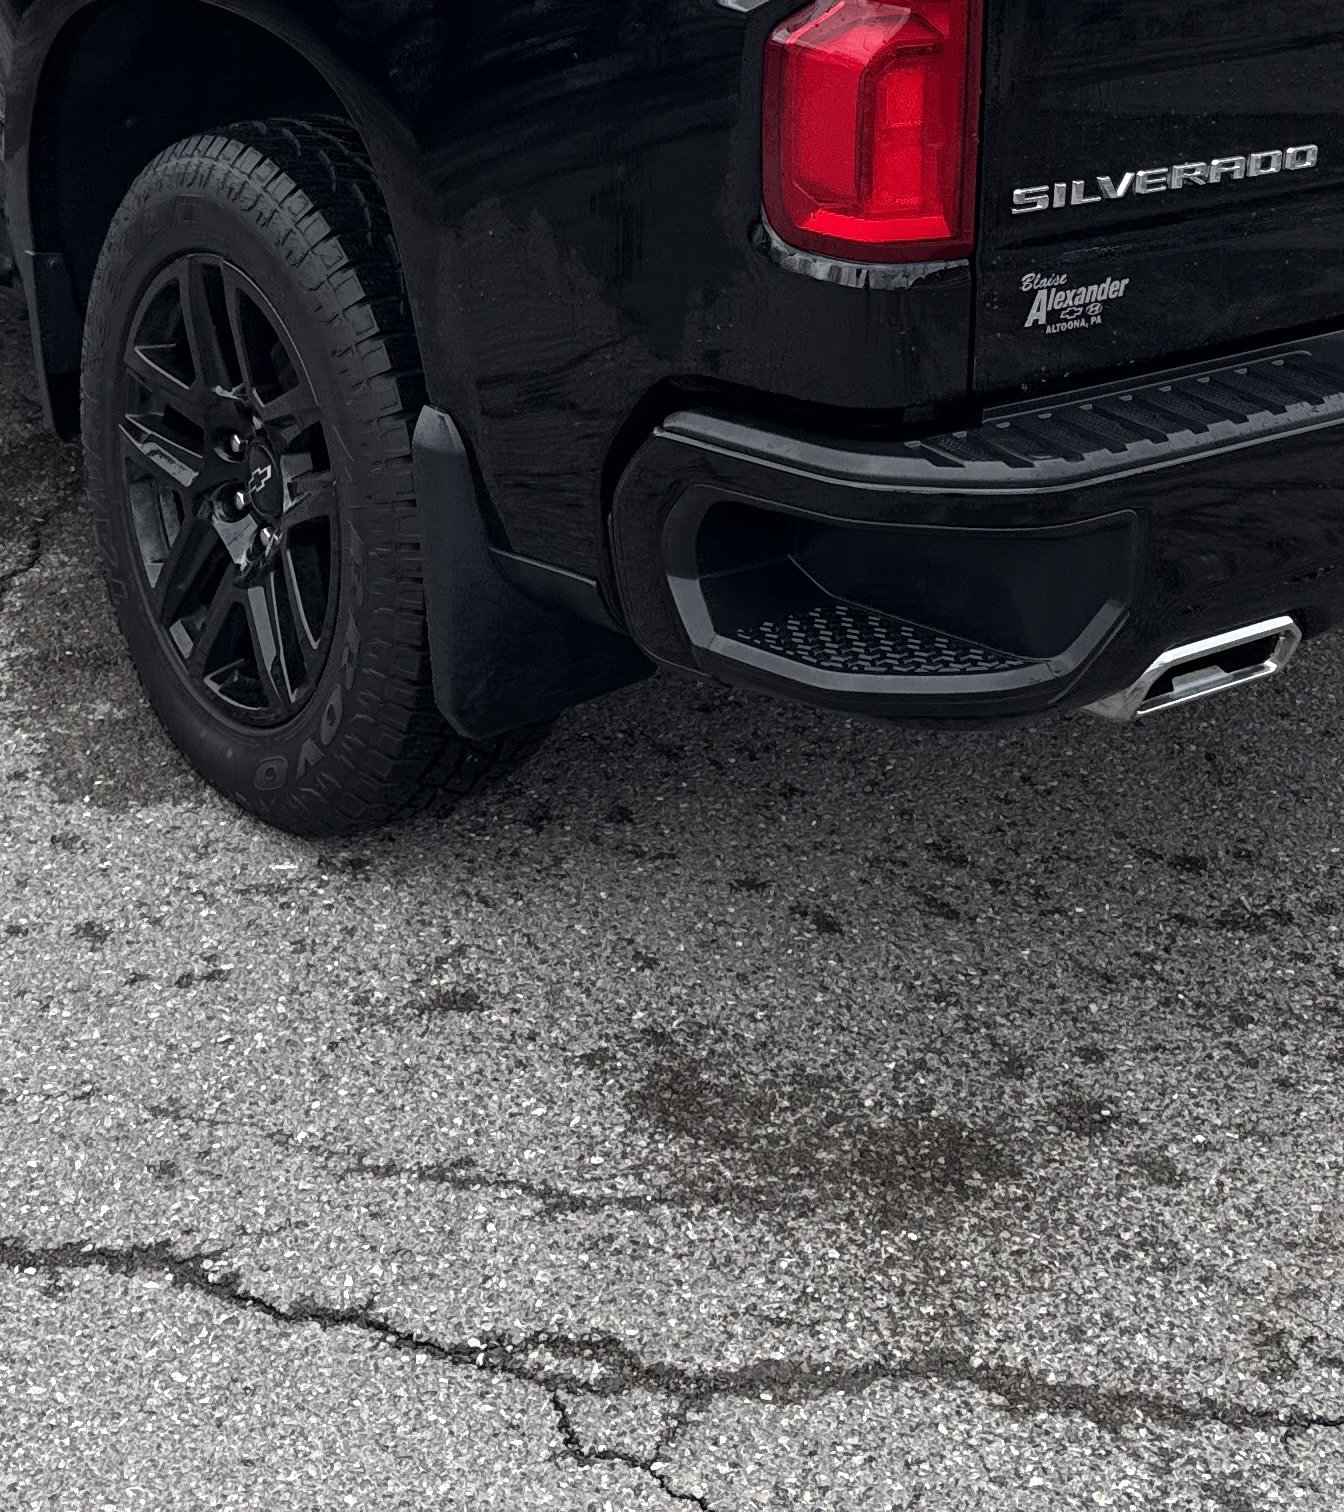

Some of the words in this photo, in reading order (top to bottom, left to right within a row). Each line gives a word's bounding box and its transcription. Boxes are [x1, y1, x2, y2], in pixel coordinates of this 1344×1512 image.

[1011, 144, 1319, 215] SILVERADO
[1021, 272, 1067, 292] Blaise
[1024, 276, 1130, 328] Alexander
[1045, 318, 1089, 335] ALTOONA,
[1090, 314, 1102, 325] PA
